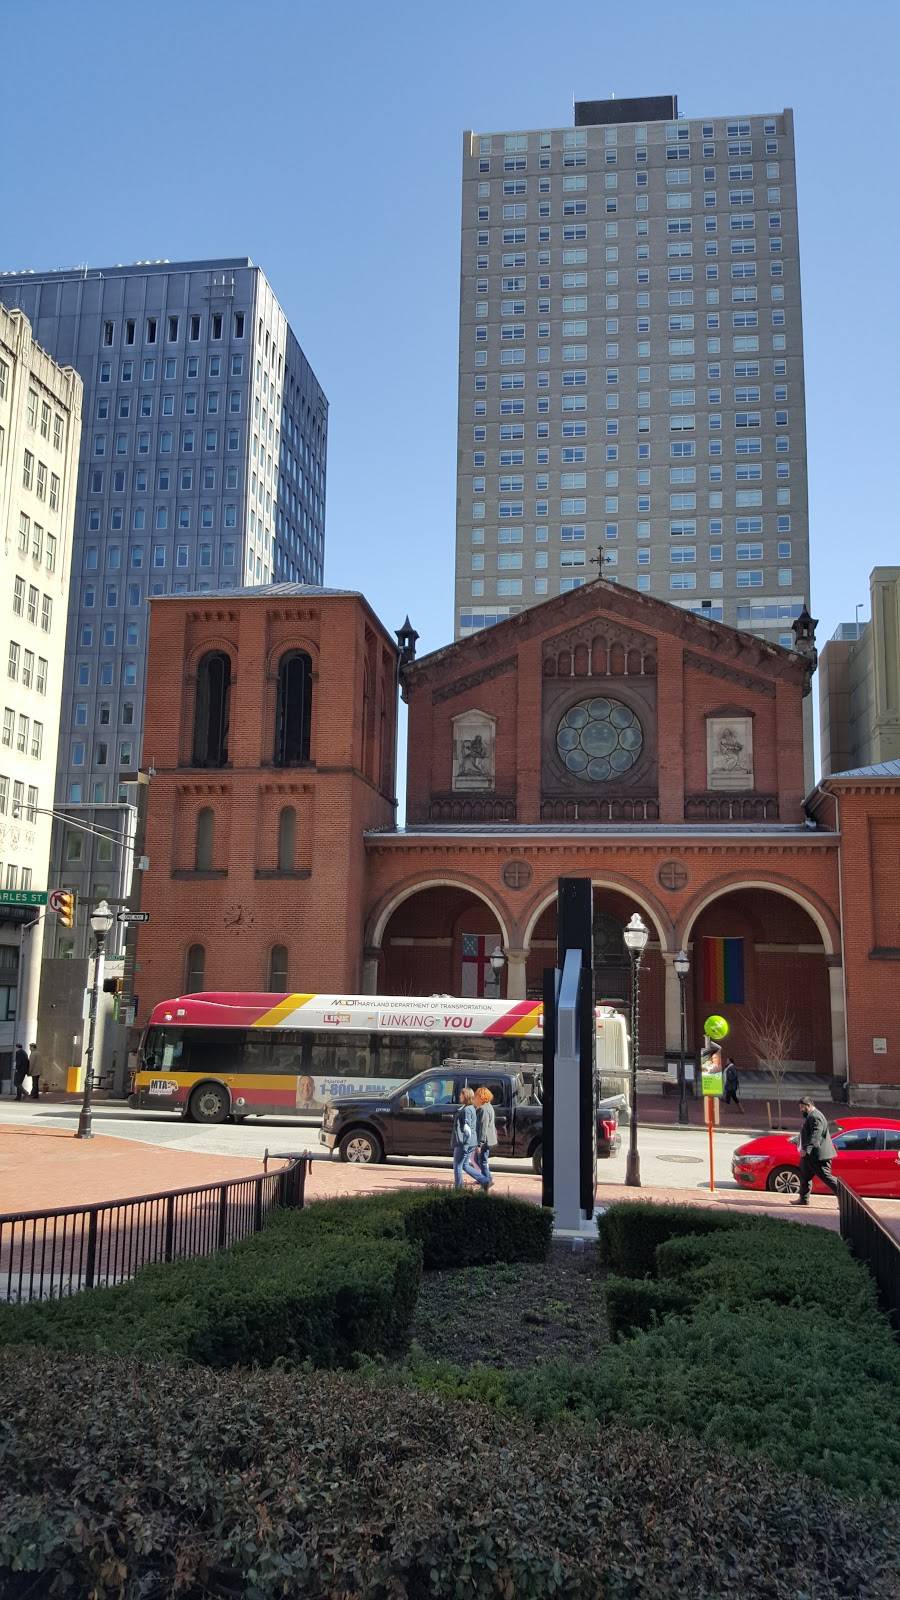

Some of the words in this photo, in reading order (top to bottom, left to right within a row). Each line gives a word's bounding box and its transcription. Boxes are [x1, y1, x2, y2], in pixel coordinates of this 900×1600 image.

[0, 893, 27, 901] RLES
[381, 1014, 435, 1028] LINKING
[443, 1015, 474, 1029] YOU
[150, 1079, 168, 1090] MTA
